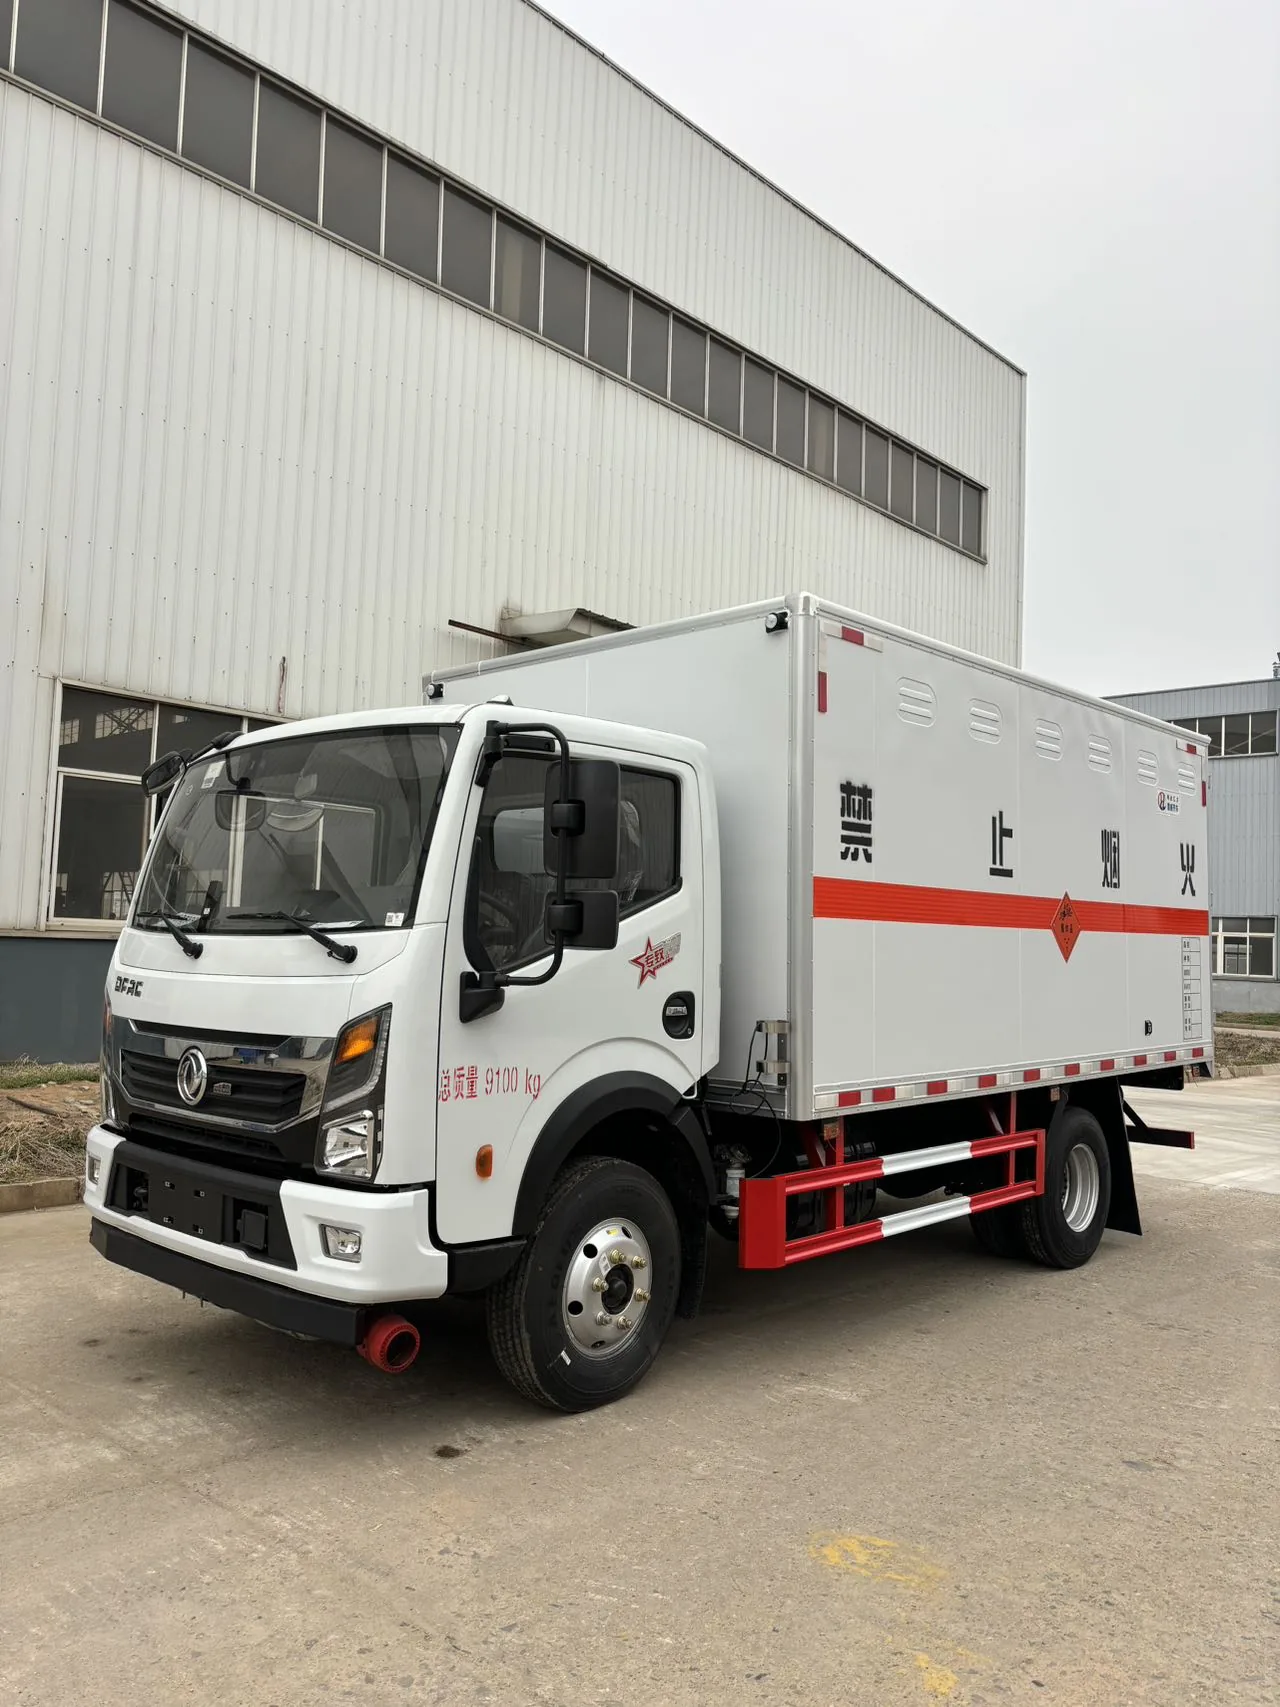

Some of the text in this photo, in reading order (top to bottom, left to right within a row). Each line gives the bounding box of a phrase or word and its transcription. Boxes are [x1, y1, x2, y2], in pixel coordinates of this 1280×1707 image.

[439, 1065, 541, 1102] 总质量 9100 kg
